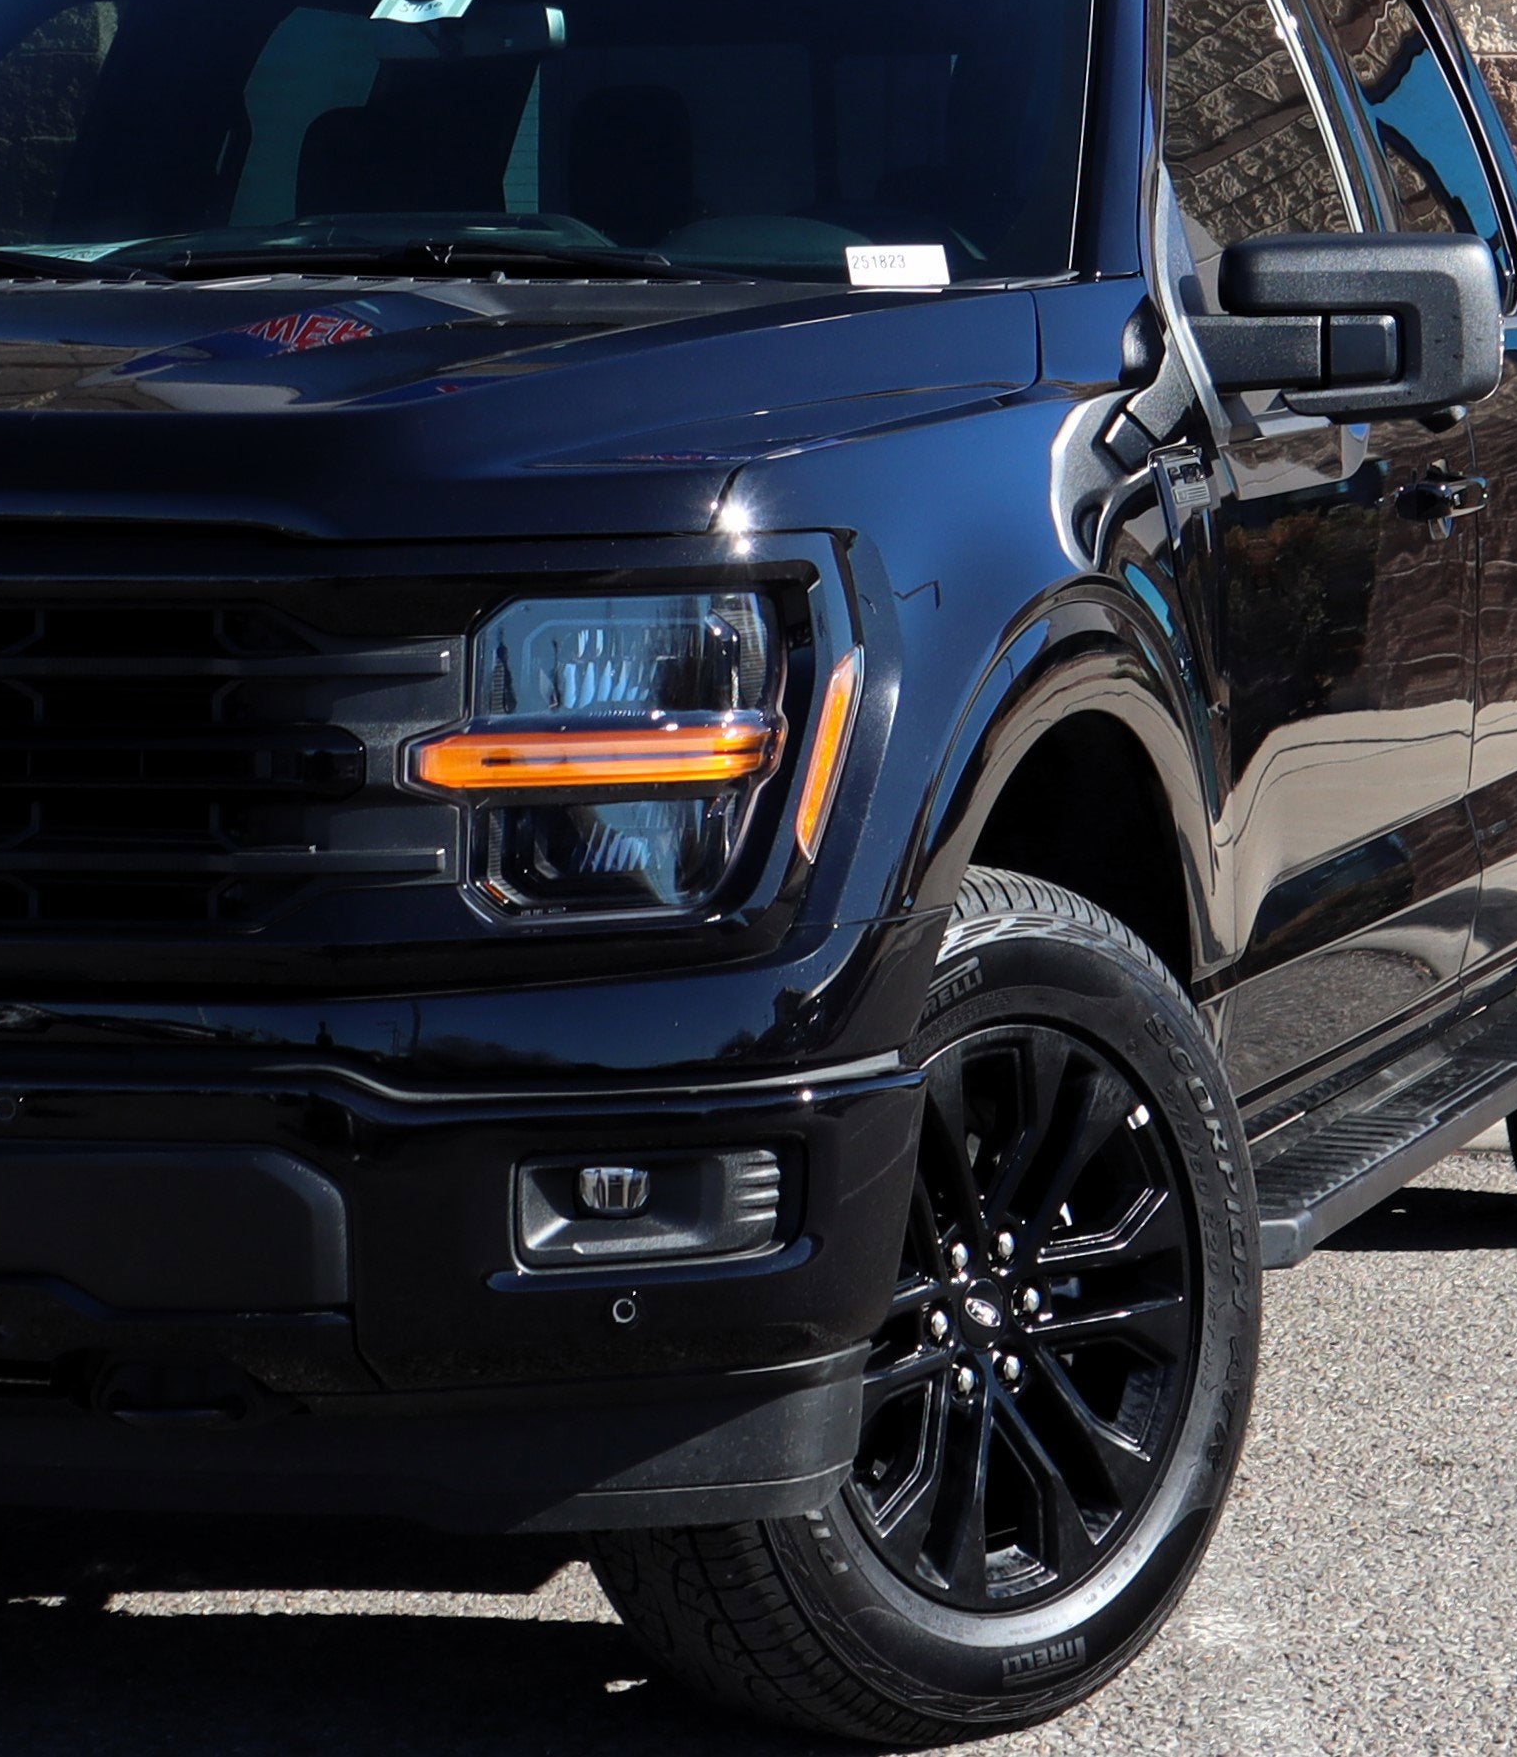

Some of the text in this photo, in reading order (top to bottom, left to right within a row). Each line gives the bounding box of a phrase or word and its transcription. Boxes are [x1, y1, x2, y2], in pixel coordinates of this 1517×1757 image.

[851, 254, 906, 269] 251823
[1144, 1012, 1248, 1314] SCORPION
[1002, 1635, 1087, 1688] PIRELLI
